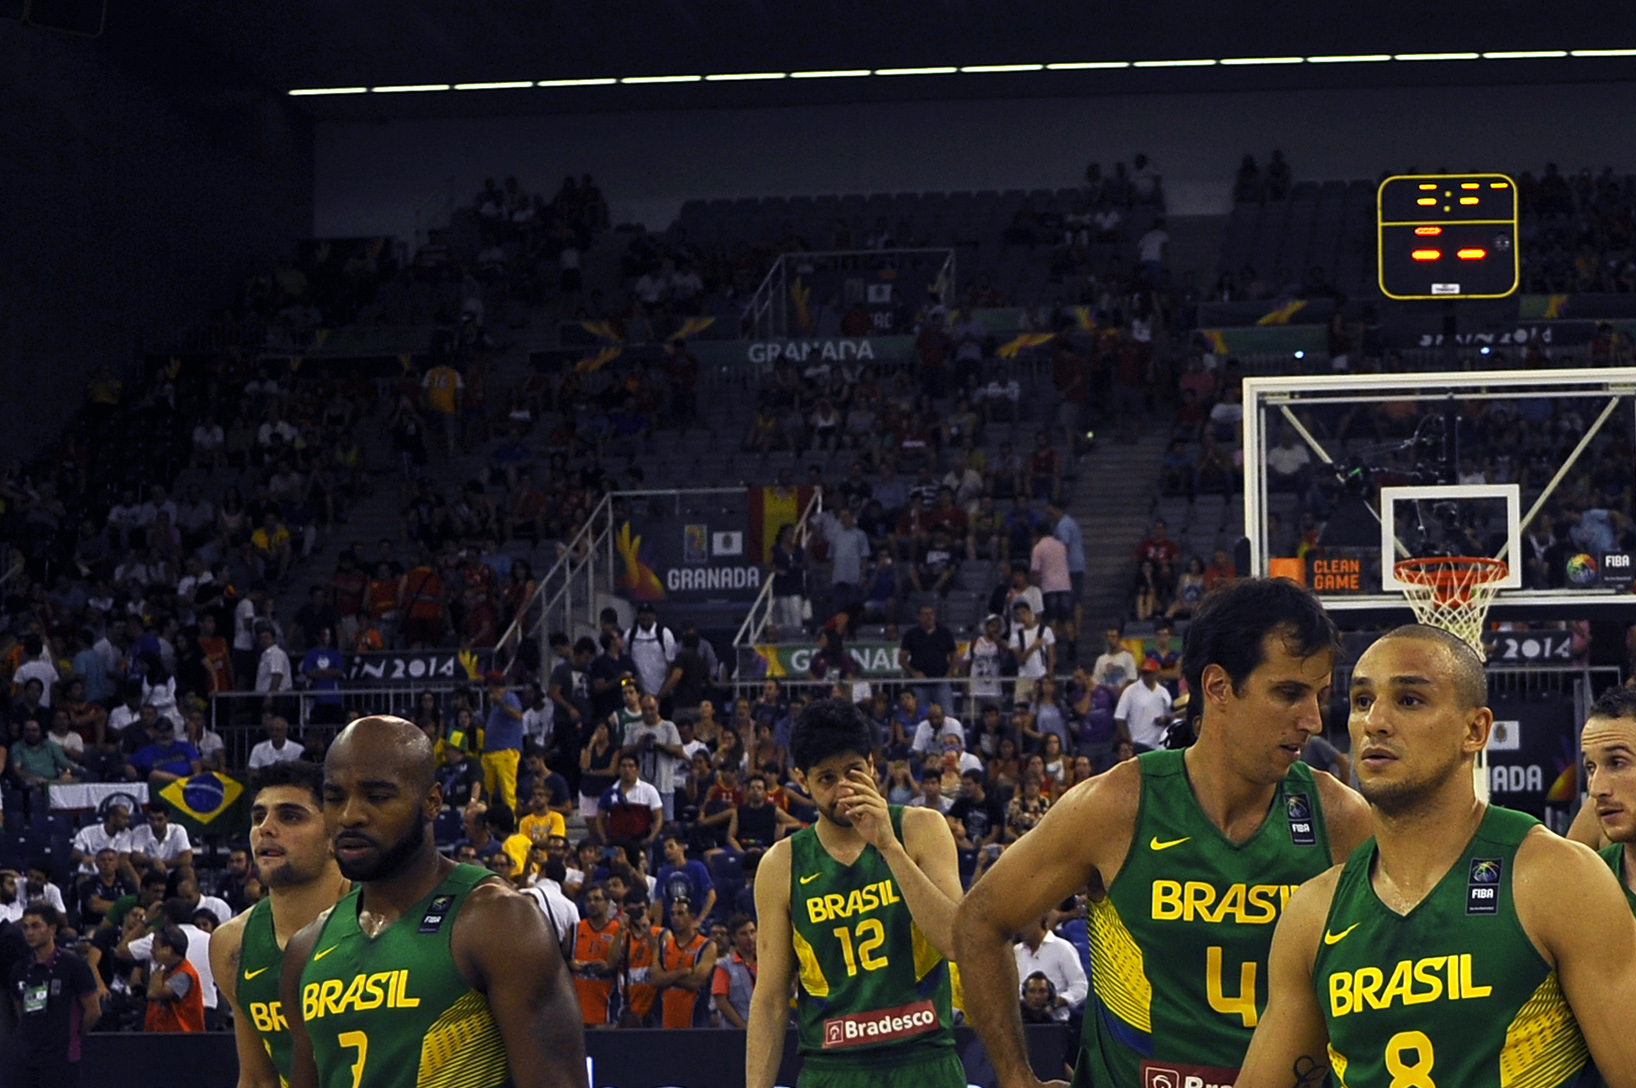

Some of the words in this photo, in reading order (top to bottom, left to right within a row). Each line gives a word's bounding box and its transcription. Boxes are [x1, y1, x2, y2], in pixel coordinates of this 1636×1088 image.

[1313, 559, 1360, 574] CLEAN
[1605, 554, 1630, 568] FIBA
[667, 566, 760, 591] GRANADA
[1313, 574, 1360, 590] GAME
[1502, 636, 1572, 659] 2014
[390, 655, 456, 679] 2014
[1487, 764, 1543, 792] ADA
[806, 879, 900, 924] BRASIL
[1471, 888, 1494, 899] FIBA
[833, 918, 889, 977] 12
[302, 968, 422, 1023] BRASIL
[1206, 945, 1259, 1028] 4
[1329, 953, 1493, 1018] BRASIL
[844, 1010, 934, 1039] Bradesco
